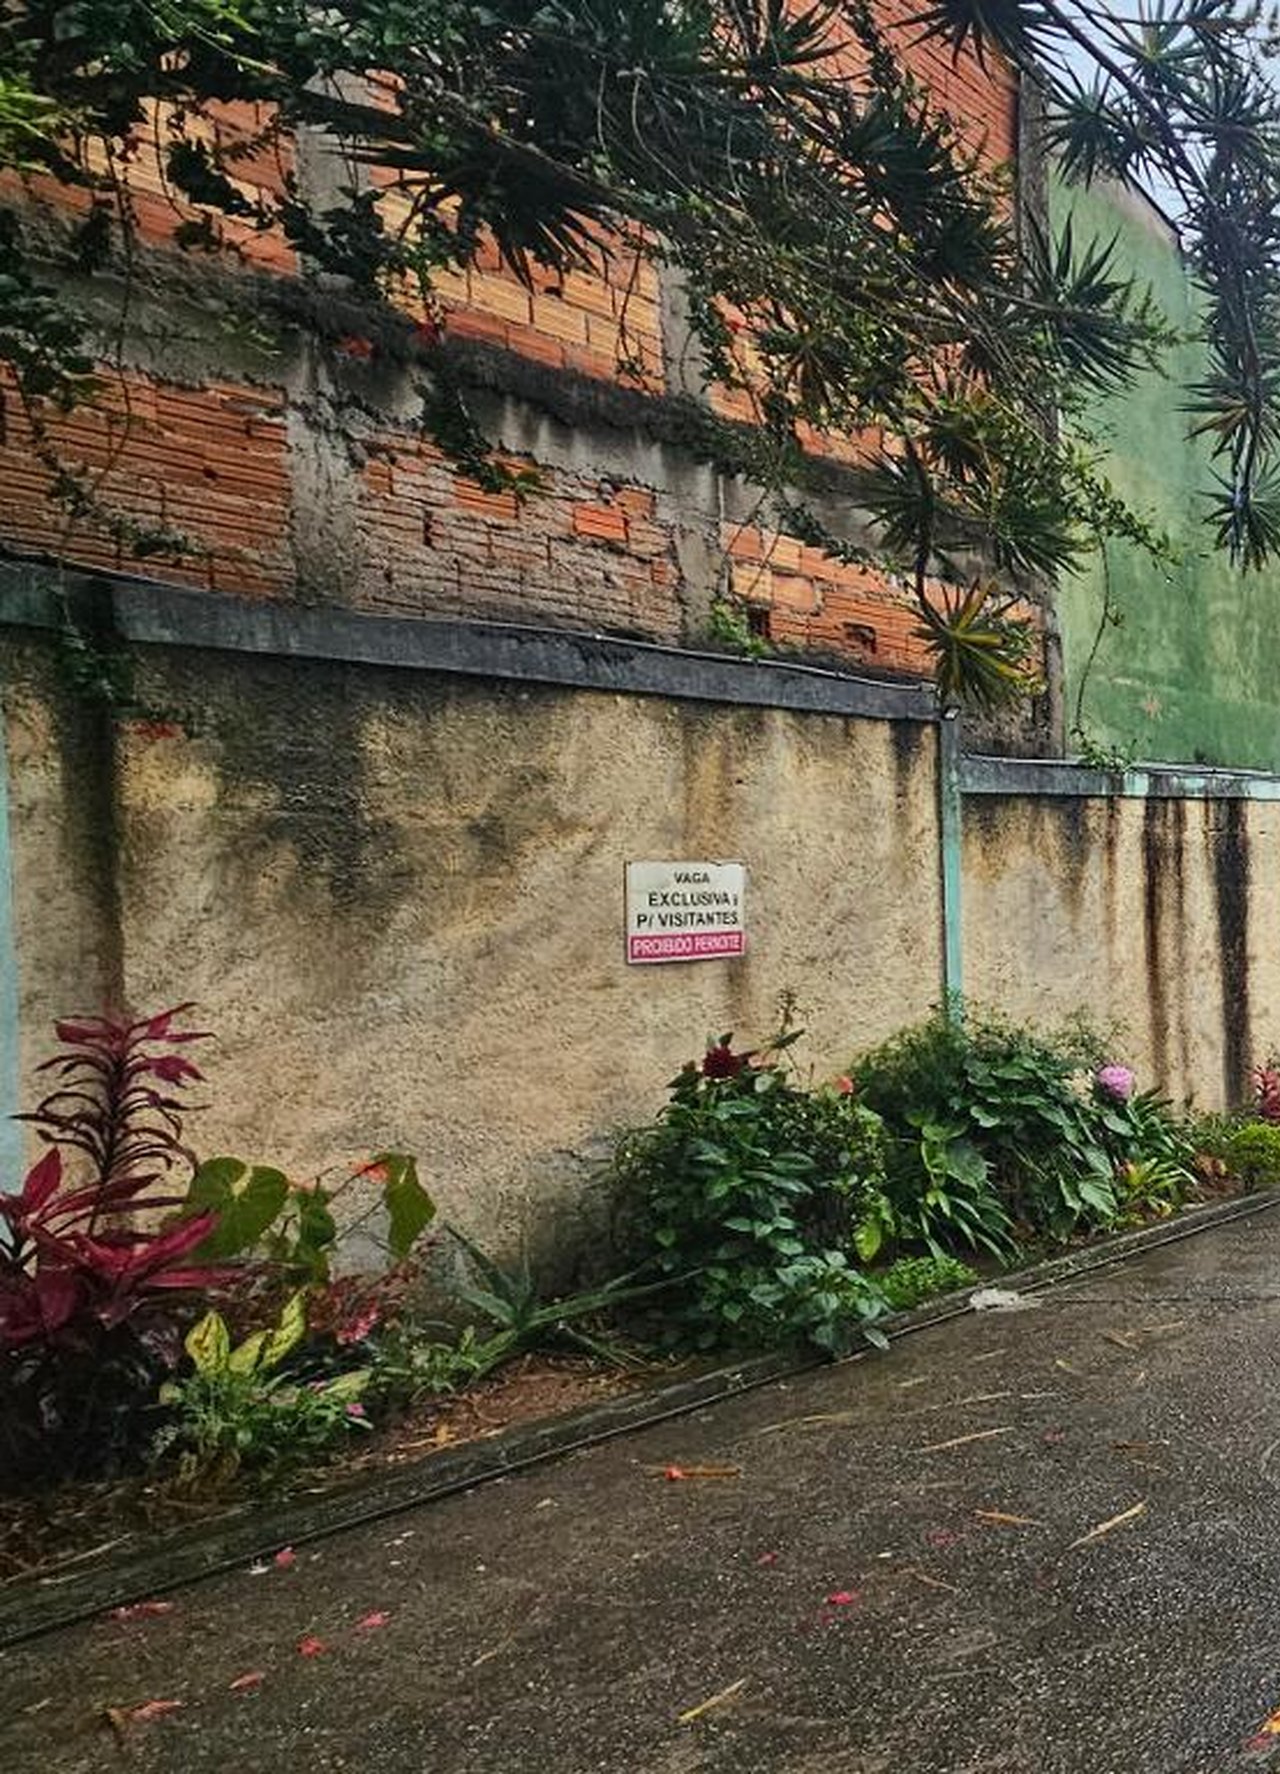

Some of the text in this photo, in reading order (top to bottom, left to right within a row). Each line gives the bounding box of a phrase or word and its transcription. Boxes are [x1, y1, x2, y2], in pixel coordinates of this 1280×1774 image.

[673, 872, 710, 883] VAGA
[648, 891, 730, 907] EXCLUSIVA
[636, 911, 738, 929] P/ VISITANTES
[634, 937, 692, 956] PROIBIDO
